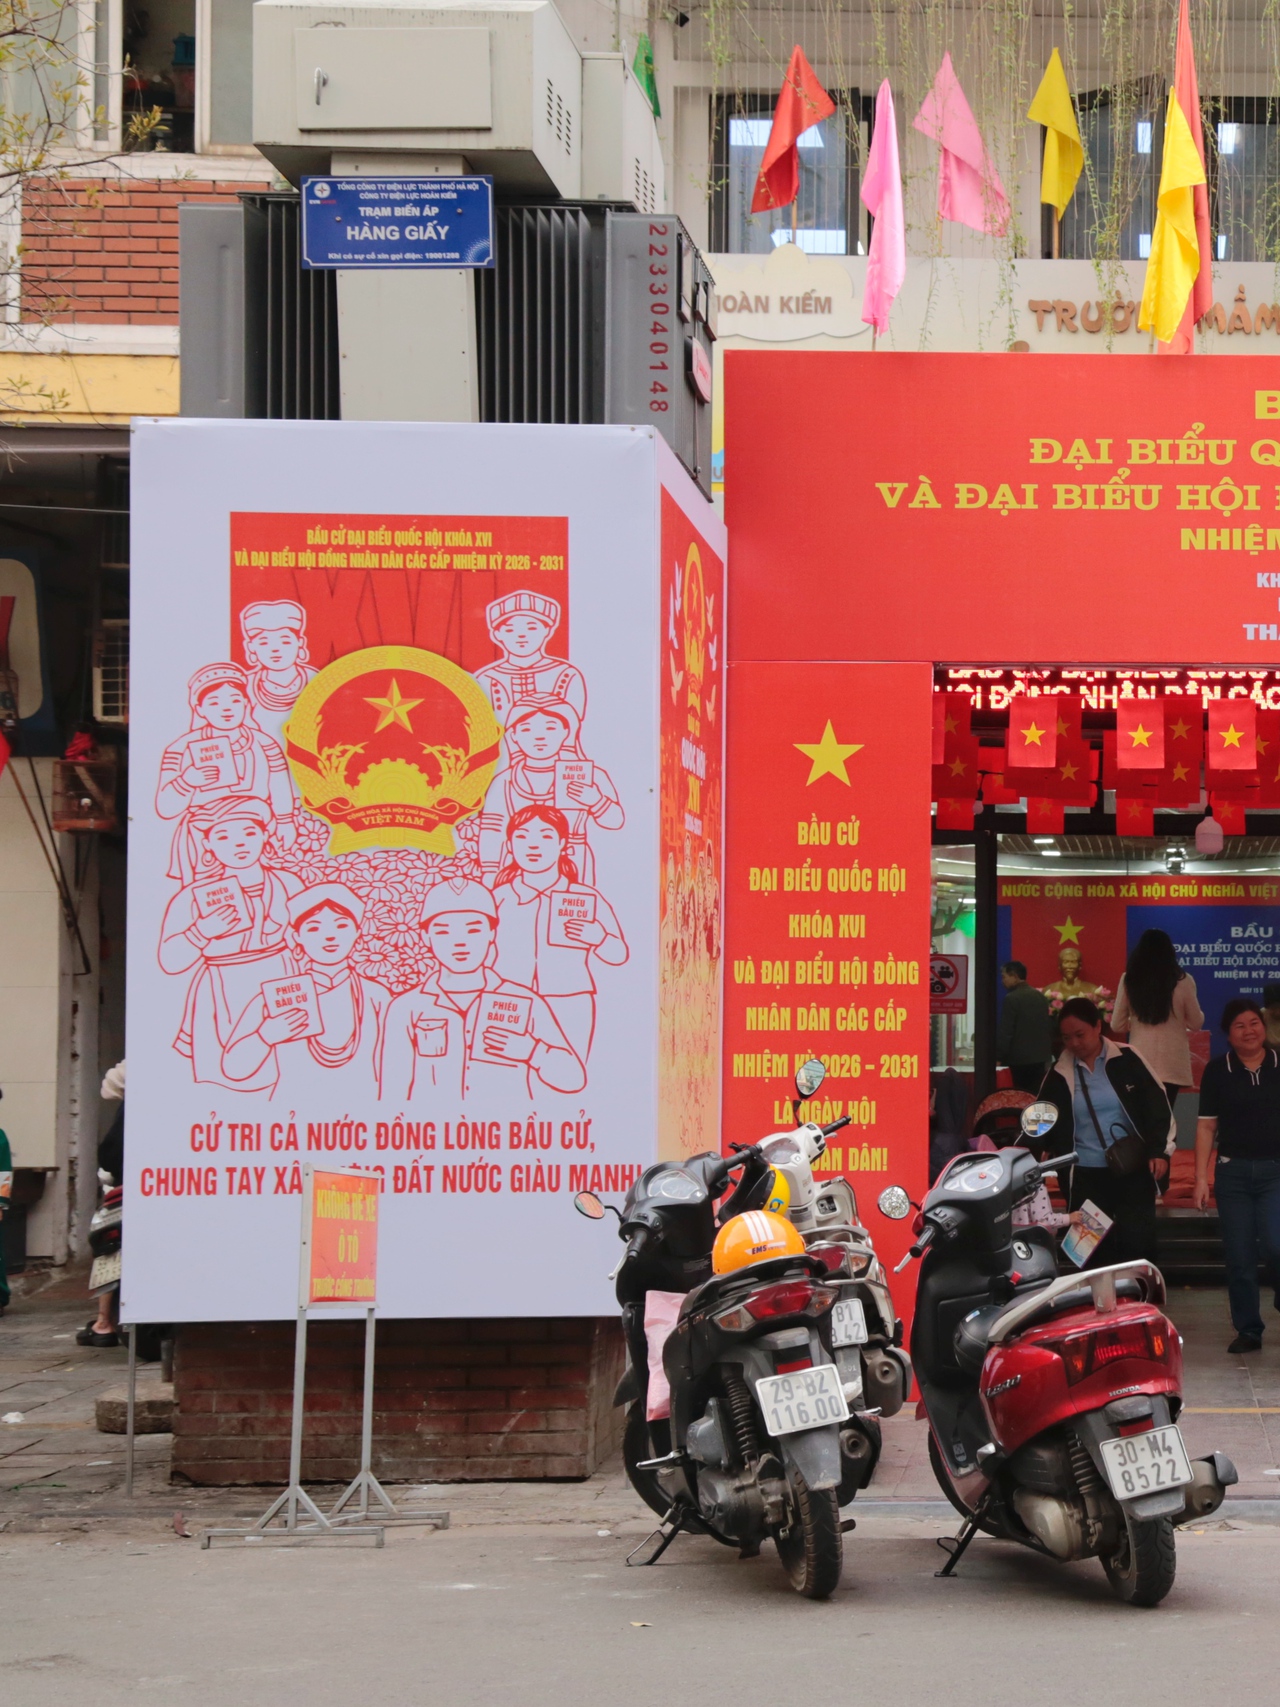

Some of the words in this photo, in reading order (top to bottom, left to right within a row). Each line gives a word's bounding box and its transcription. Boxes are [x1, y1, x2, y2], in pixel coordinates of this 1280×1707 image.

[359, 207, 391, 219] TRẠM
[394, 203, 420, 216] BIẾN
[423, 205, 439, 216] ÁP
[347, 222, 399, 240] HÀNG
[405, 221, 449, 240] GIẤY
[780, 289, 832, 314] KIẾM
[649, 224, 670, 412] 2233040148
[1030, 439, 1113, 470] ĐẠI
[1127, 422, 1237, 465] BIỂU
[876, 475, 941, 508] VÀ
[955, 484, 1038, 516] ĐẠI
[1053, 469, 1162, 510] BIỂU
[1176, 477, 1260, 517] HỘI
[307, 525, 328, 544] BẦU
[331, 524, 346, 545] CỬ
[347, 530, 365, 548] ĐẠI
[368, 525, 392, 545] BIỂU
[394, 526, 422, 547] QUỐC
[425, 529, 442, 549] HỘI
[445, 529, 472, 546] KHÓA
[475, 532, 492, 546] XVI
[362, 814, 392, 825] VIỆT
[395, 814, 425, 826] NAM
[798, 813, 830, 845] BẦU
[837, 815, 860, 845] CỬ
[749, 868, 777, 896] ĐẠI
[784, 858, 821, 891] BIỂU
[828, 860, 872, 893] QUỐC
[878, 864, 905, 896] HỘI
[1002, 880, 1040, 897] NƯỚC
[1044, 883, 1083, 900] CỘNG
[1087, 883, 1115, 897] HÒA
[1119, 883, 1139, 897] XÃ
[1142, 883, 1166, 900] HỘI
[1169, 880, 1199, 897] CHỦ
[1202, 883, 1245, 897] NGHĨA
[1250, 883, 1279, 900] VIỆT
[789, 910, 833, 938] KHÓA
[839, 915, 865, 938] XVI
[1231, 922, 1273, 938] BẦU
[493, 1001, 518, 1012] PHIẾU
[191, 1111, 223, 1152] CỬ
[228, 1123, 261, 1151] TRI
[270, 1111, 299, 1151] CẢ
[307, 1114, 367, 1151] NƯỚC
[375, 1113, 436, 1150] ĐỒNG
[444, 1115, 500, 1150] LÒNG
[509, 1112, 552, 1149] BẦU
[561, 1109, 595, 1152] CỬ,
[752, 1245, 767, 1255] EMS
[770, 1372, 829, 1404] 29-B2
[1108, 1385, 1142, 1397] HONDA
[771, 1395, 842, 1430] 116.00
[1113, 1432, 1172, 1467] 30-M4
[1121, 1459, 1181, 1493] 8522
